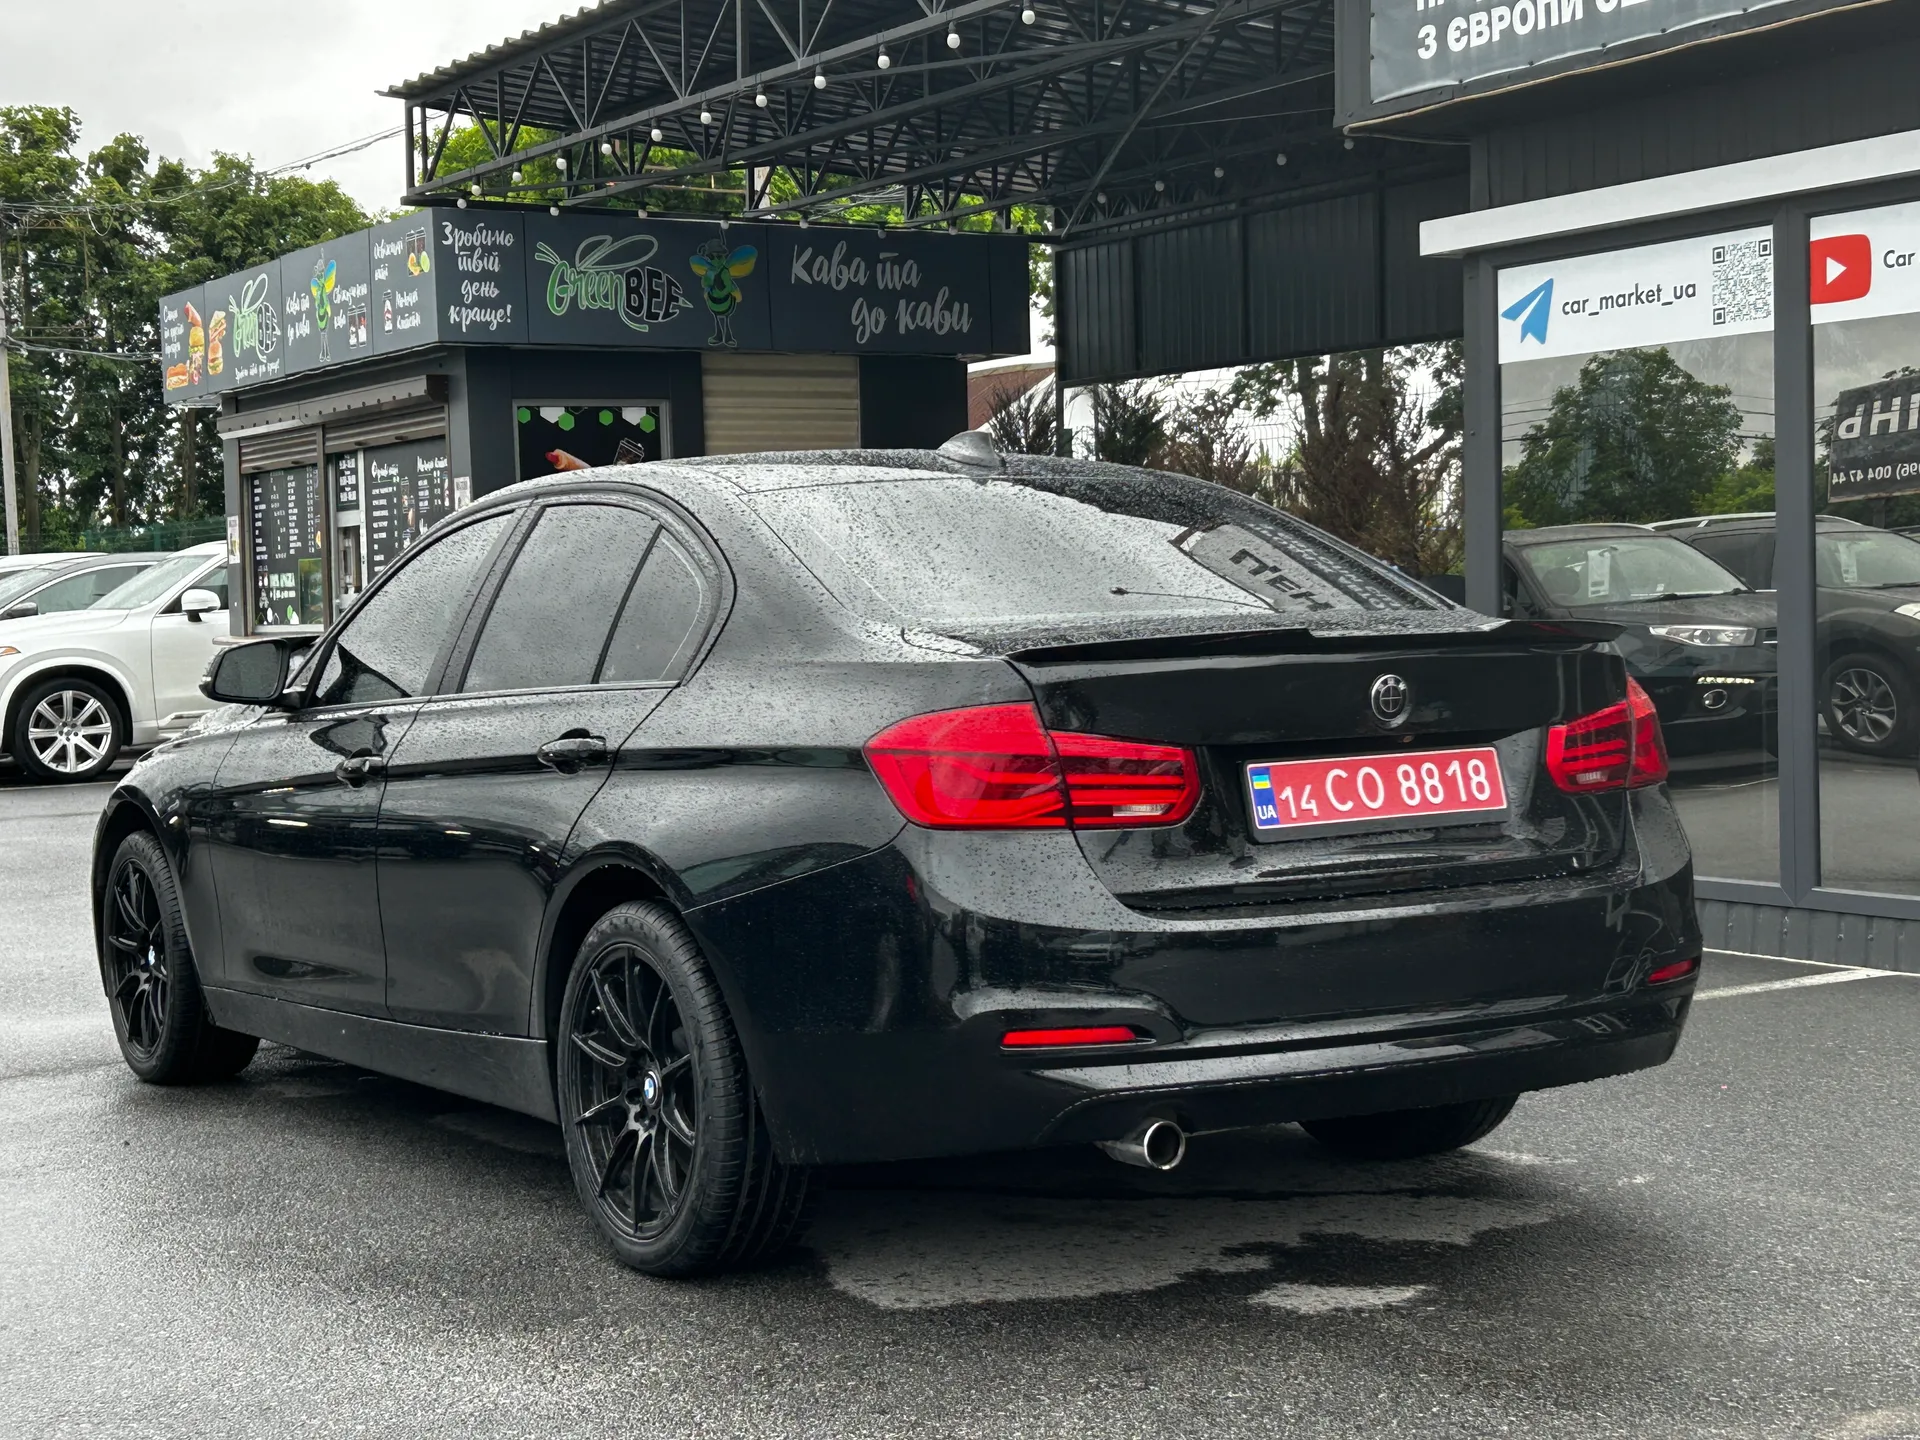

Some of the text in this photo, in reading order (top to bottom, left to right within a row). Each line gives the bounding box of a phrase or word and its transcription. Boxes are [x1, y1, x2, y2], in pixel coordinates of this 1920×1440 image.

[1417, 0, 1584, 59] З ЄВРОПИ
[441, 221, 515, 254] Зробимо
[457, 248, 501, 273] твій
[791, 240, 922, 290] Кава та
[1882, 249, 1917, 269] Car
[461, 279, 500, 304] день
[1561, 282, 1697, 317] car_market_ua
[449, 304, 513, 332] краще!
[851, 286, 973, 344] до кави
[1279, 785, 1319, 818] 14
[1396, 758, 1491, 806] 8818
[1257, 804, 1277, 820] UA
